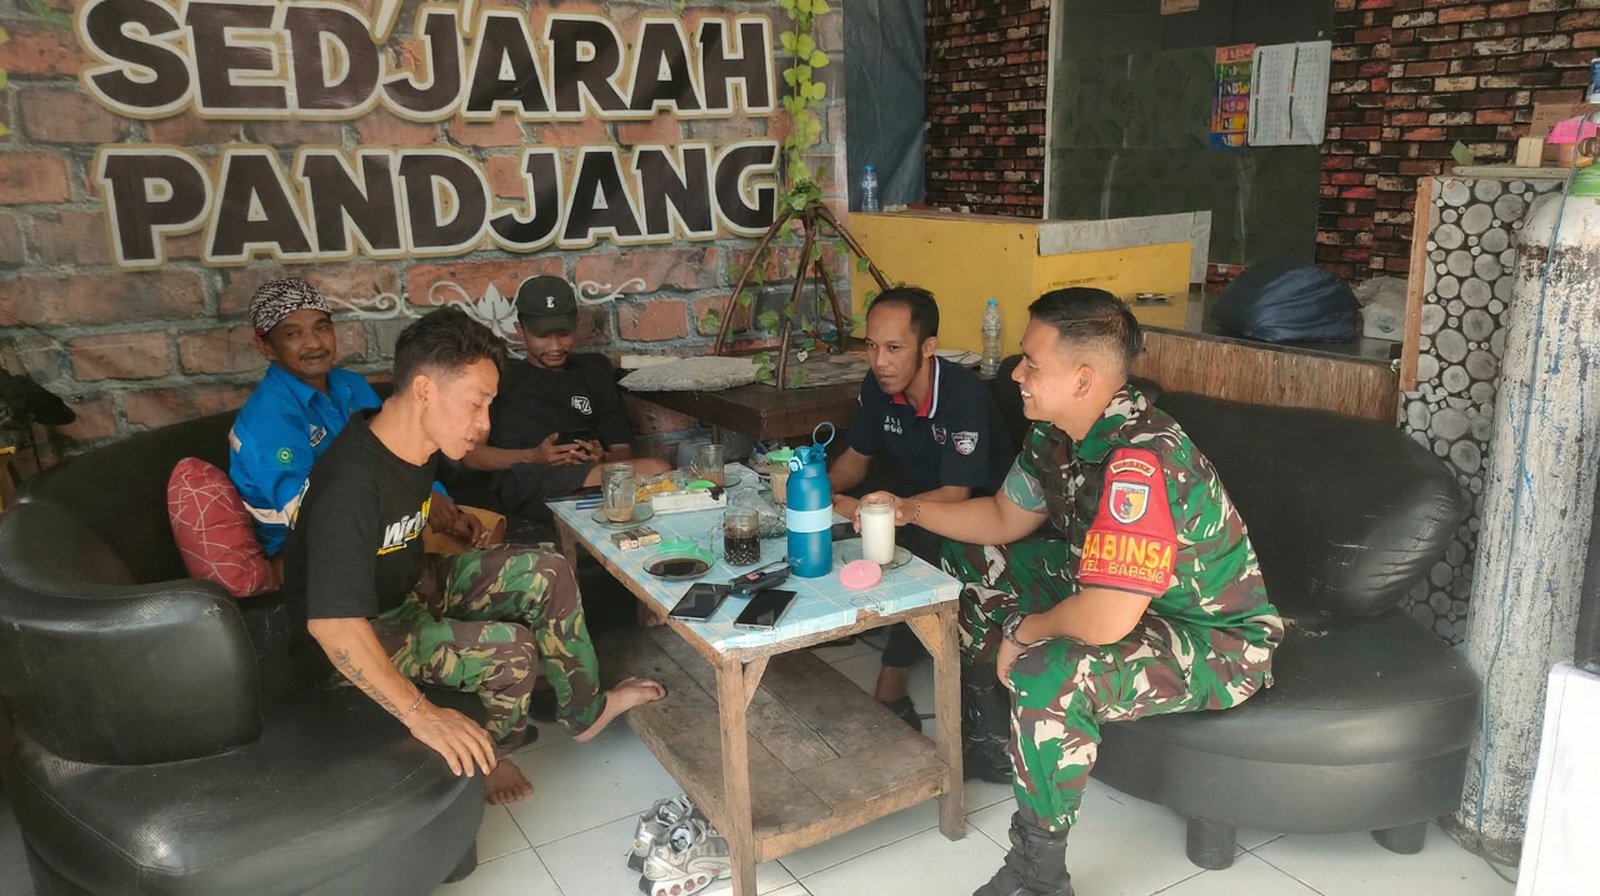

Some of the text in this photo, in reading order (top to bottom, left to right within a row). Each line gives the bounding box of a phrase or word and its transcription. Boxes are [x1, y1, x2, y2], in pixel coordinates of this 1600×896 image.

[80, 0, 773, 119] SEDJARAH
[101, 141, 778, 264] PANDJANG
[1081, 533, 1172, 572] BABINSA
